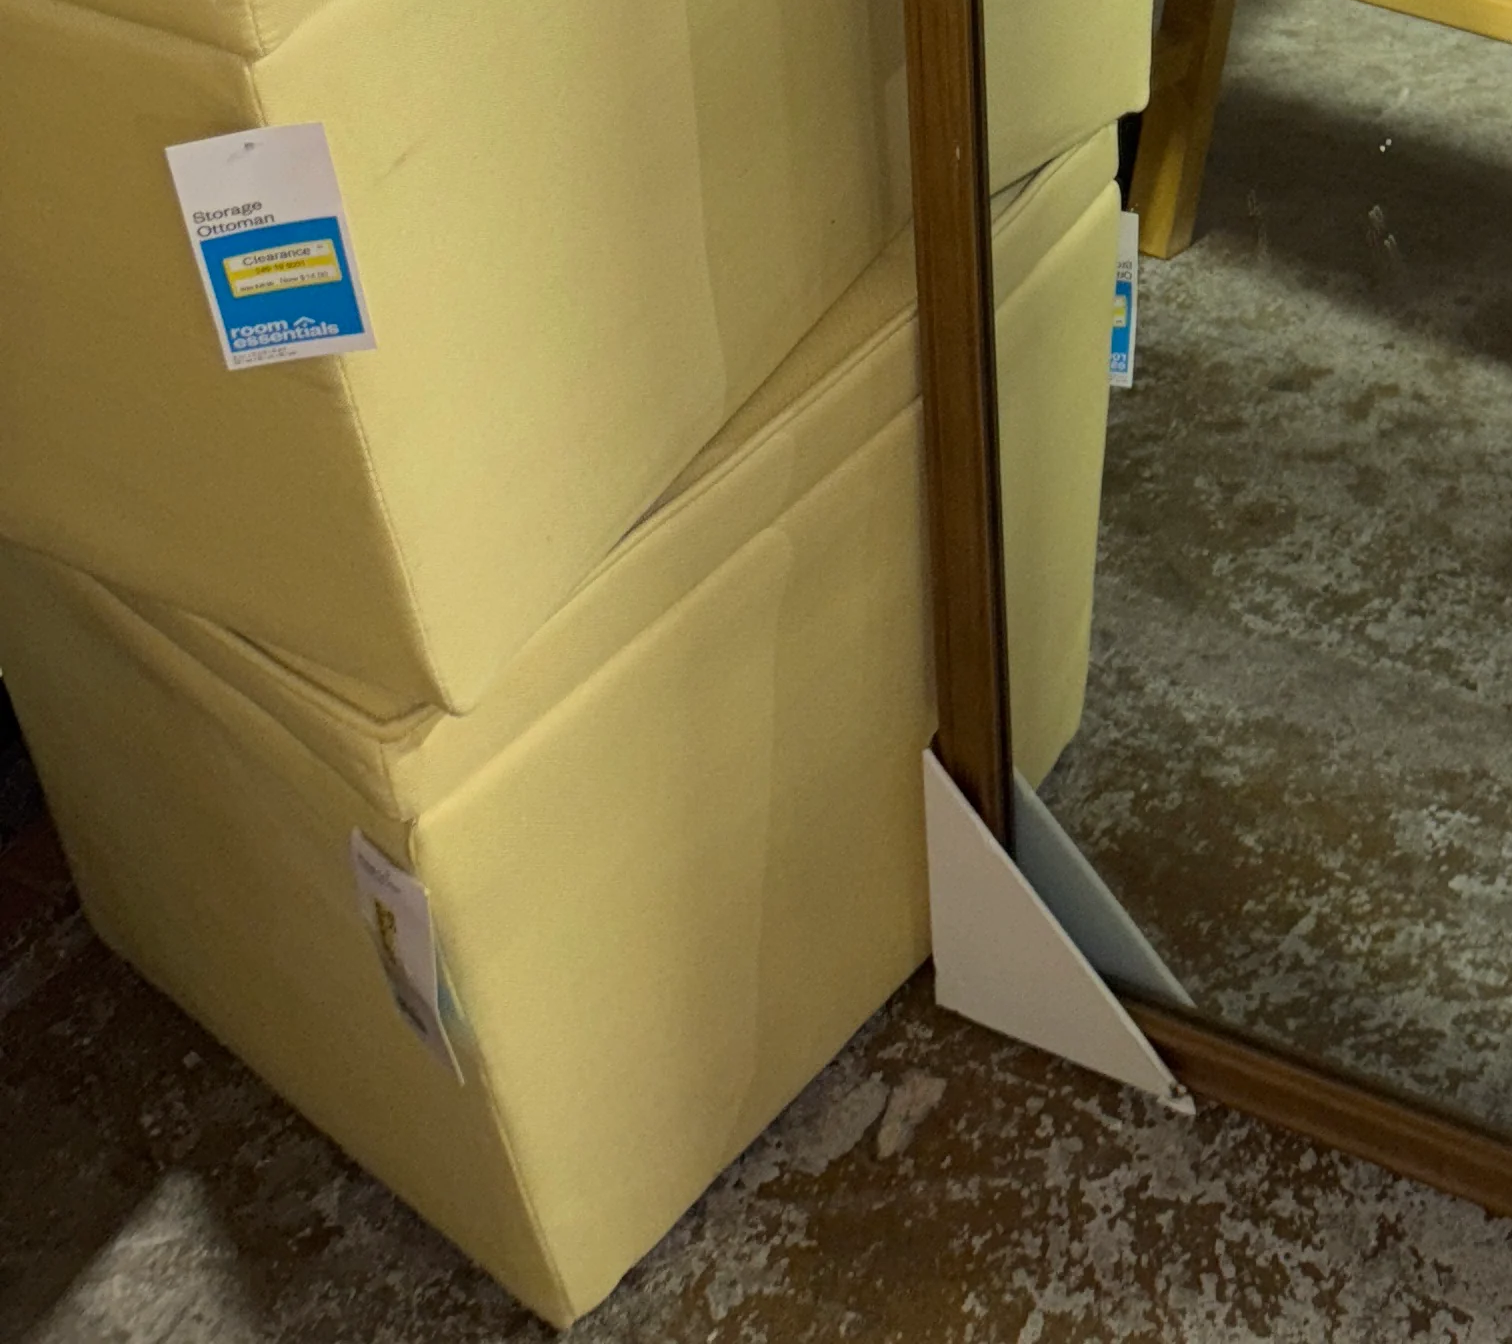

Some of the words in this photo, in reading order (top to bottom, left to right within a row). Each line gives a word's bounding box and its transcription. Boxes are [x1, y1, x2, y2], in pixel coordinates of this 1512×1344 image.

[193, 201, 263, 224] Storage
[196, 213, 275, 237] Ottoman
[242, 246, 312, 267] Clearance
[230, 319, 288, 339] room
[233, 321, 340, 349] essentials
